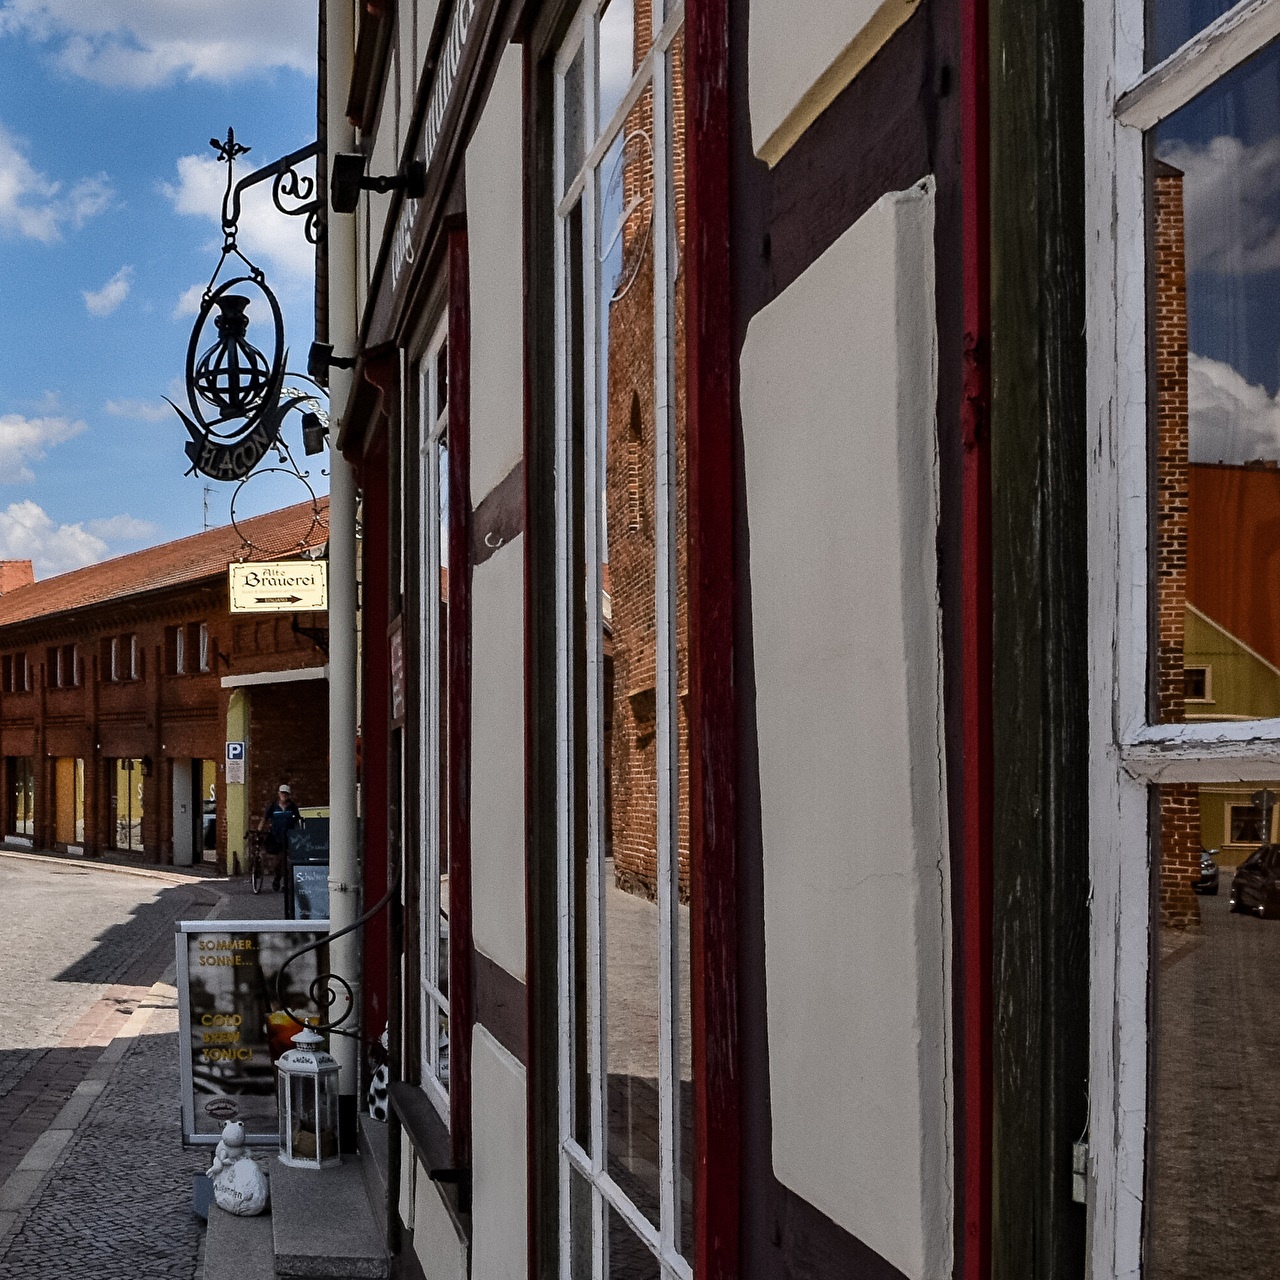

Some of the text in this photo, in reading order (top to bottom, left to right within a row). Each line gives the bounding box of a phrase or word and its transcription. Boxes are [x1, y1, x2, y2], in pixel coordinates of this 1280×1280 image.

[200, 424, 270, 478] FLACON
[243, 571, 315, 587] Brauerei
[262, 568, 286, 577] Alte
[228, 744, 242, 759] P
[201, 1013, 242, 1027] COLD
[203, 1031, 240, 1044] BREW
[202, 1047, 253, 1061] TONIC!
